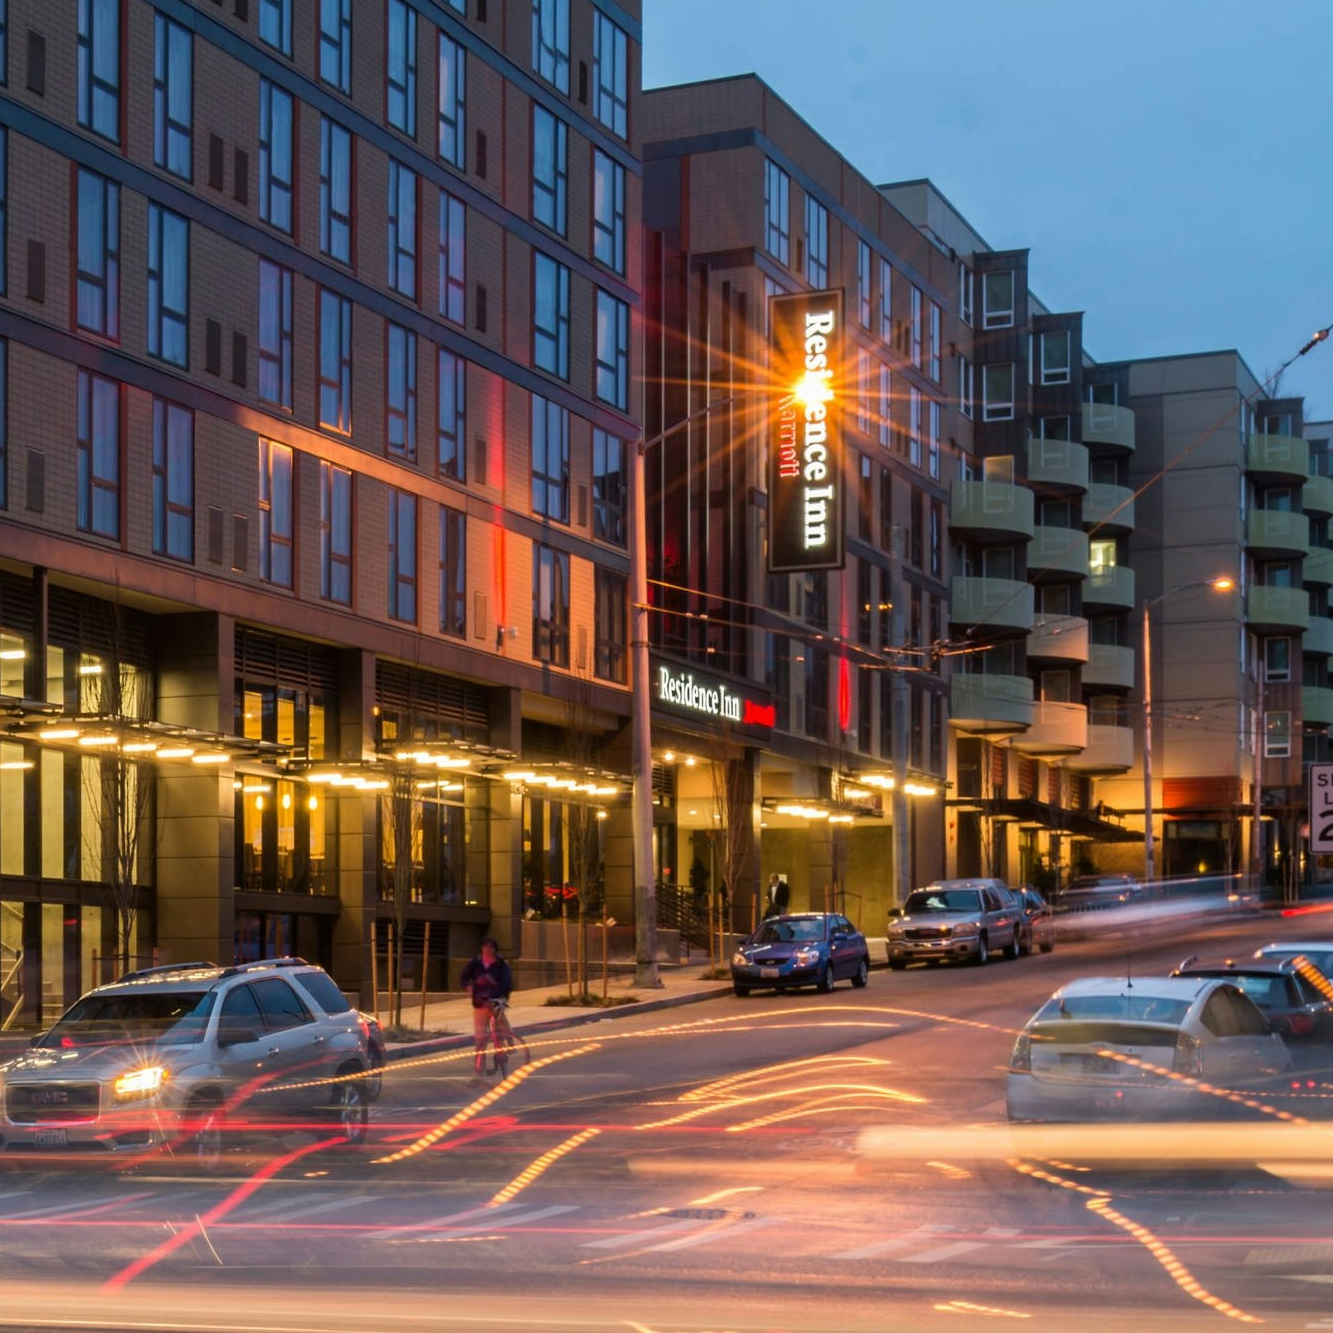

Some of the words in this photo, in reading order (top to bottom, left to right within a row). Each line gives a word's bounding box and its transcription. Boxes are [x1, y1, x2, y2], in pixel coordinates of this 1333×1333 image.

[804, 310, 834, 481] Resience
[804, 485, 834, 550] Inn
[660, 666, 719, 715] Residence
[719, 685, 741, 722] Inn
